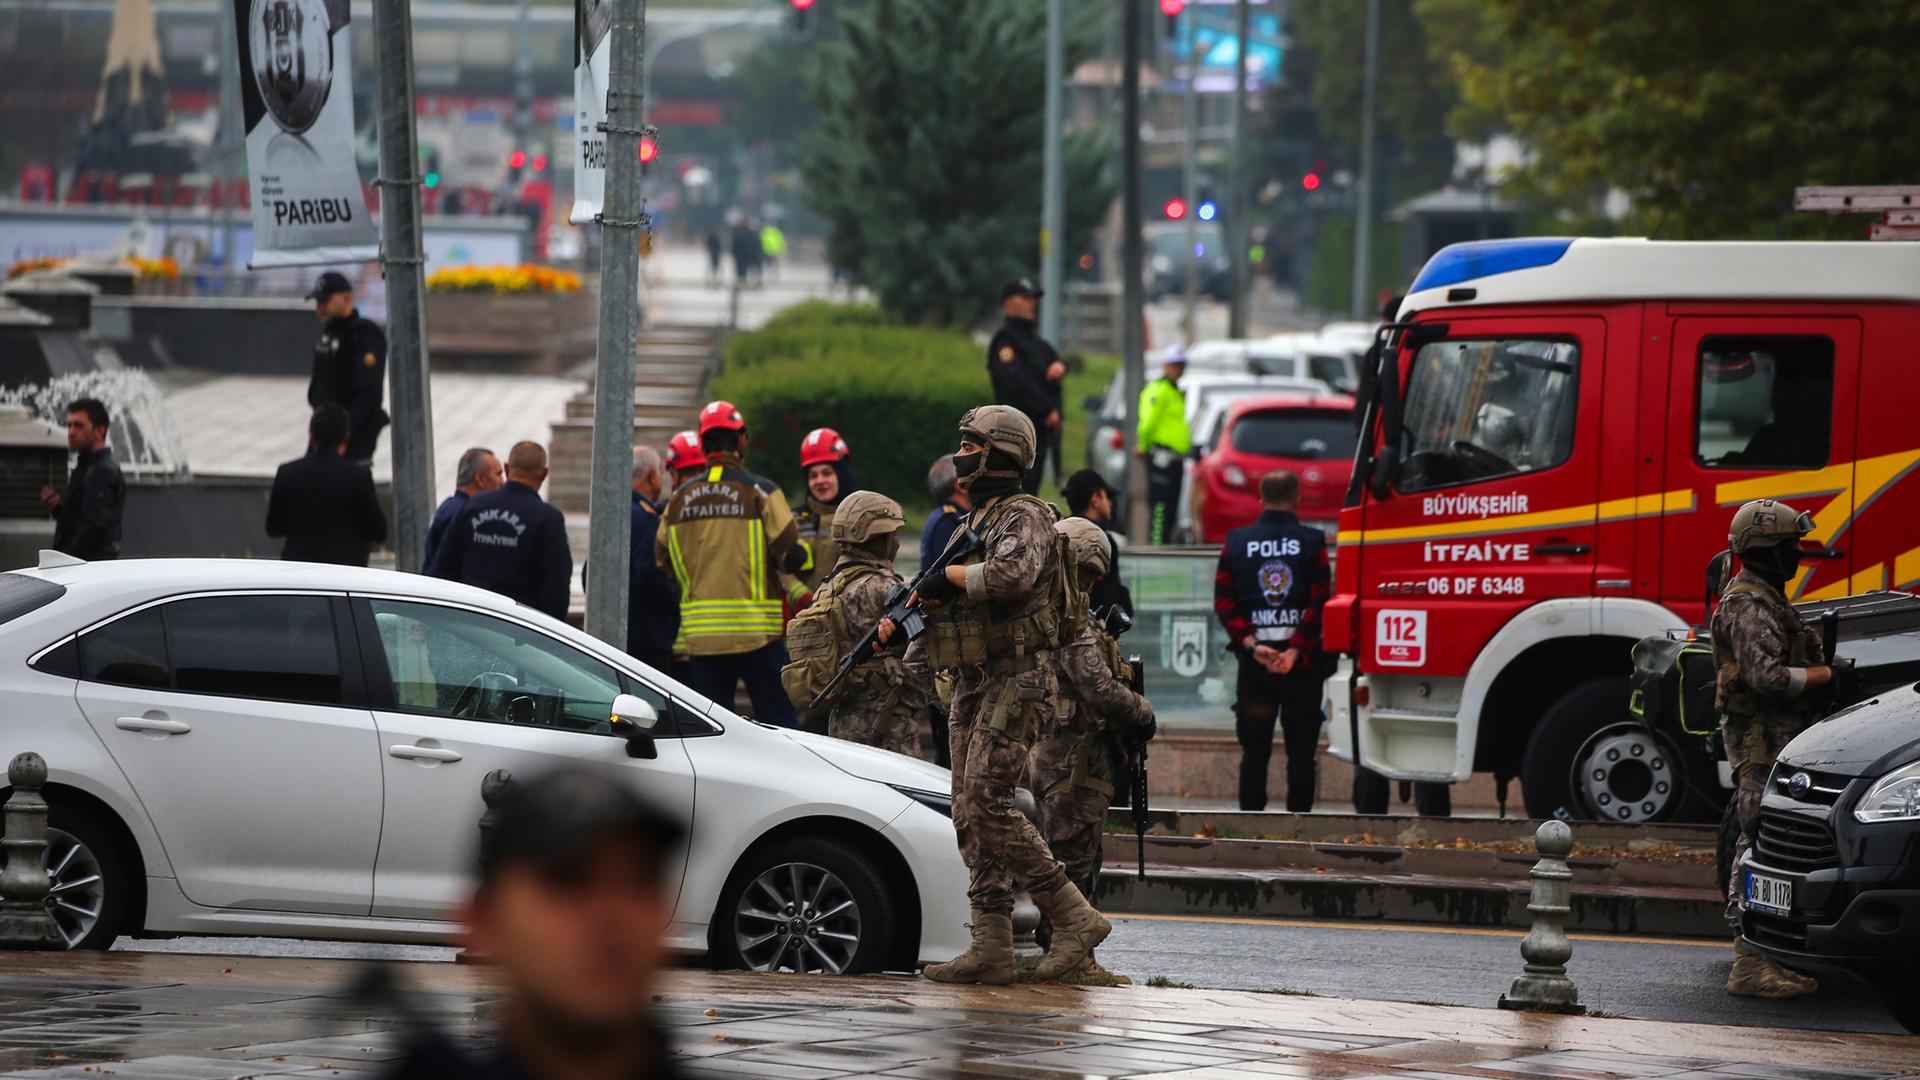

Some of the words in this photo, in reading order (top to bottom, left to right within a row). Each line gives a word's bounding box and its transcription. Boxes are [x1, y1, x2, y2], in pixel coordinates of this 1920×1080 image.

[683, 484, 739, 505] ANKARA
[1423, 491, 1528, 519] BÜYÜKŞEHİR
[472, 509, 526, 536] ANKARA
[1424, 540, 1530, 562] İTFAİYE
[1428, 577, 1449, 594] 06
[1454, 577, 1477, 594] DF
[1481, 577, 1524, 594] 6348
[1384, 616, 1416, 641] 112
[1751, 876, 1759, 900] 06
[1774, 881, 1791, 906] 1178
